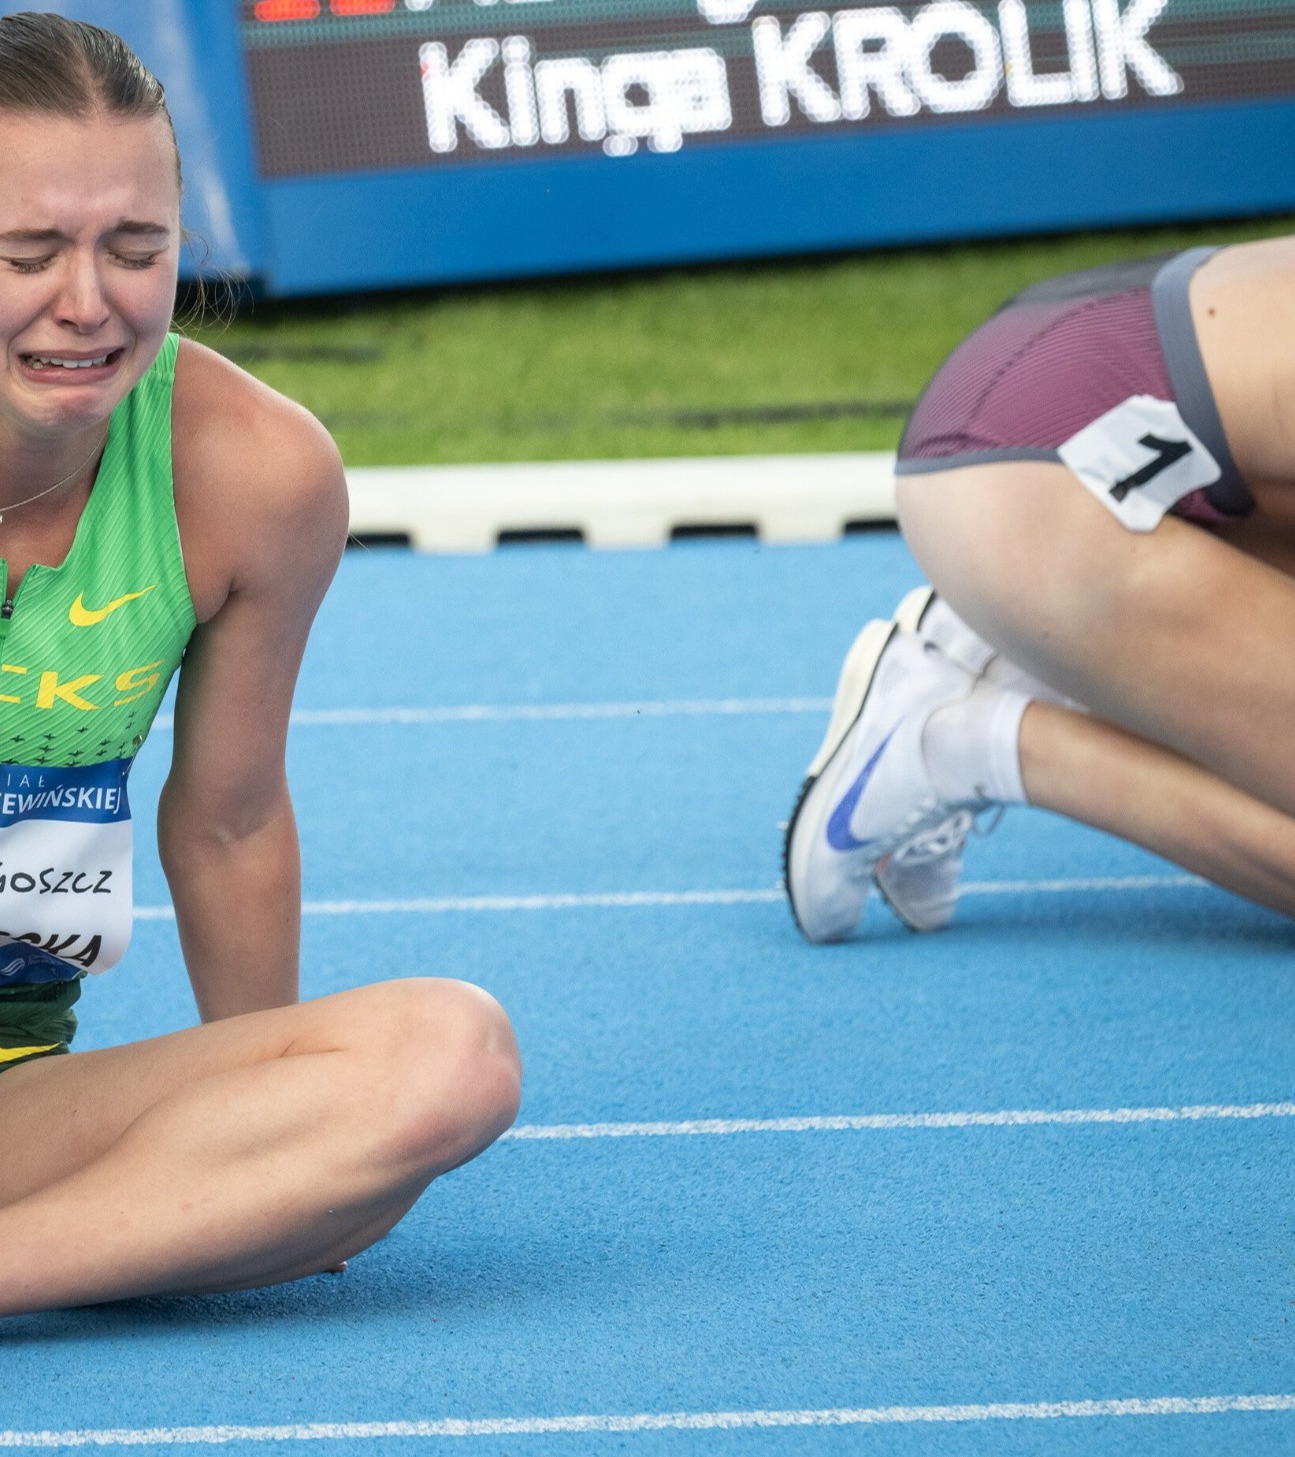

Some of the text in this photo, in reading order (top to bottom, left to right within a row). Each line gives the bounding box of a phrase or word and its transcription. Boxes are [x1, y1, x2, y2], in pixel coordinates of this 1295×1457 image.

[419, 0, 1184, 157] Kinga KROLIK
[1109, 433, 1193, 503] 1
